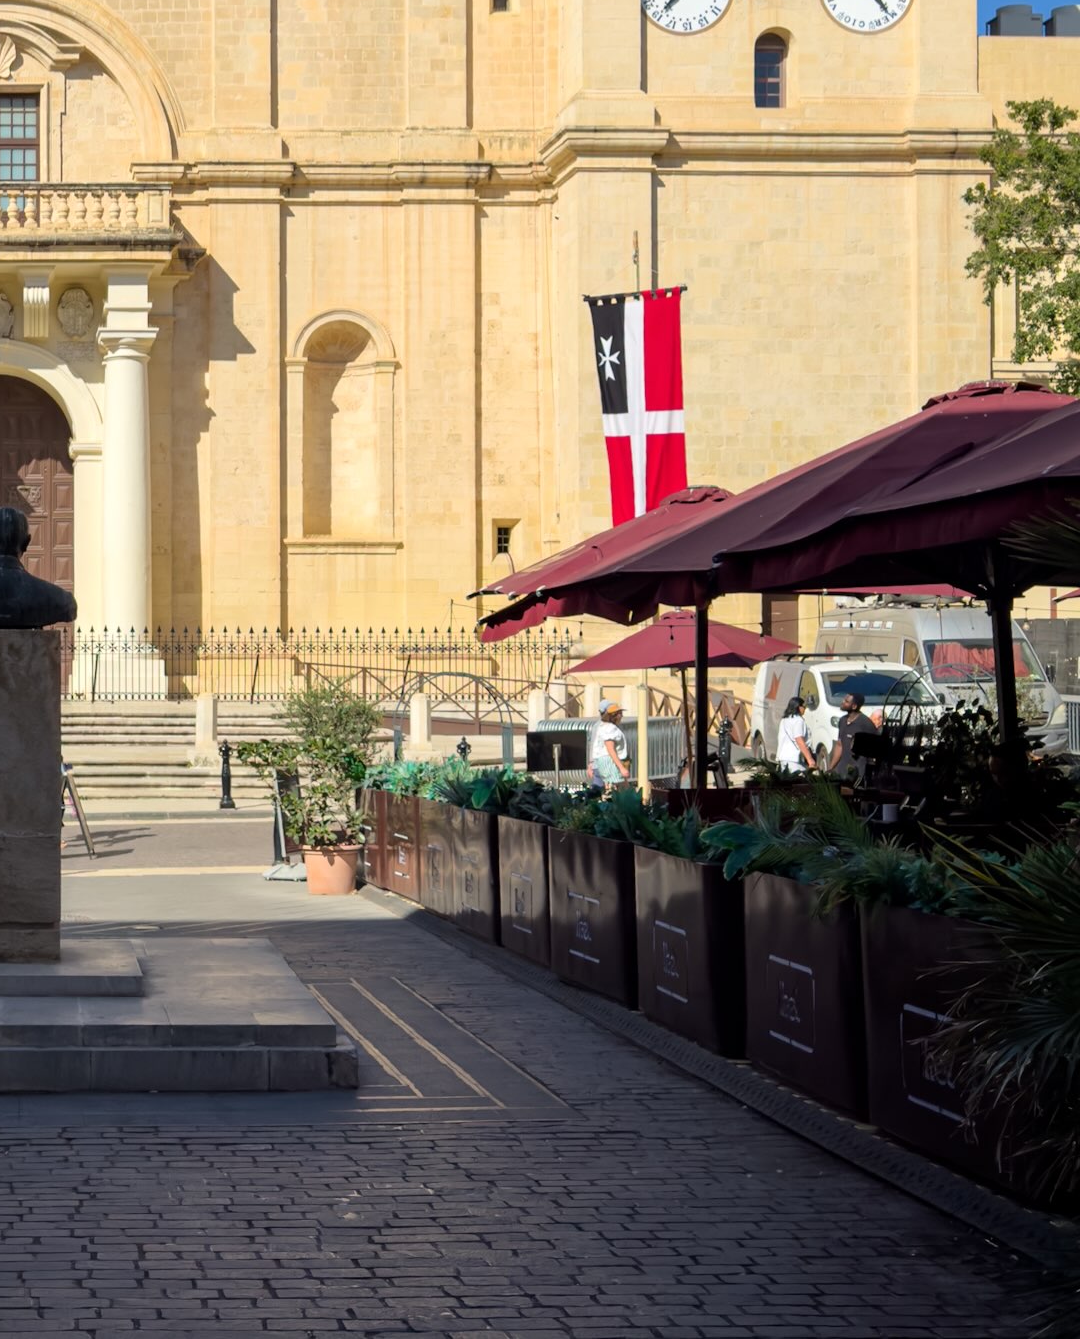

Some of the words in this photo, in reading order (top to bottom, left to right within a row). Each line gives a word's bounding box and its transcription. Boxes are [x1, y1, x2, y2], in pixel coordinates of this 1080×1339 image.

[652, 11, 663, 21] 19
[711, 6, 721, 16] 11
[666, 20, 676, 29] 17
[683, 22, 692, 31] 15
[698, 16, 709, 27] 13
